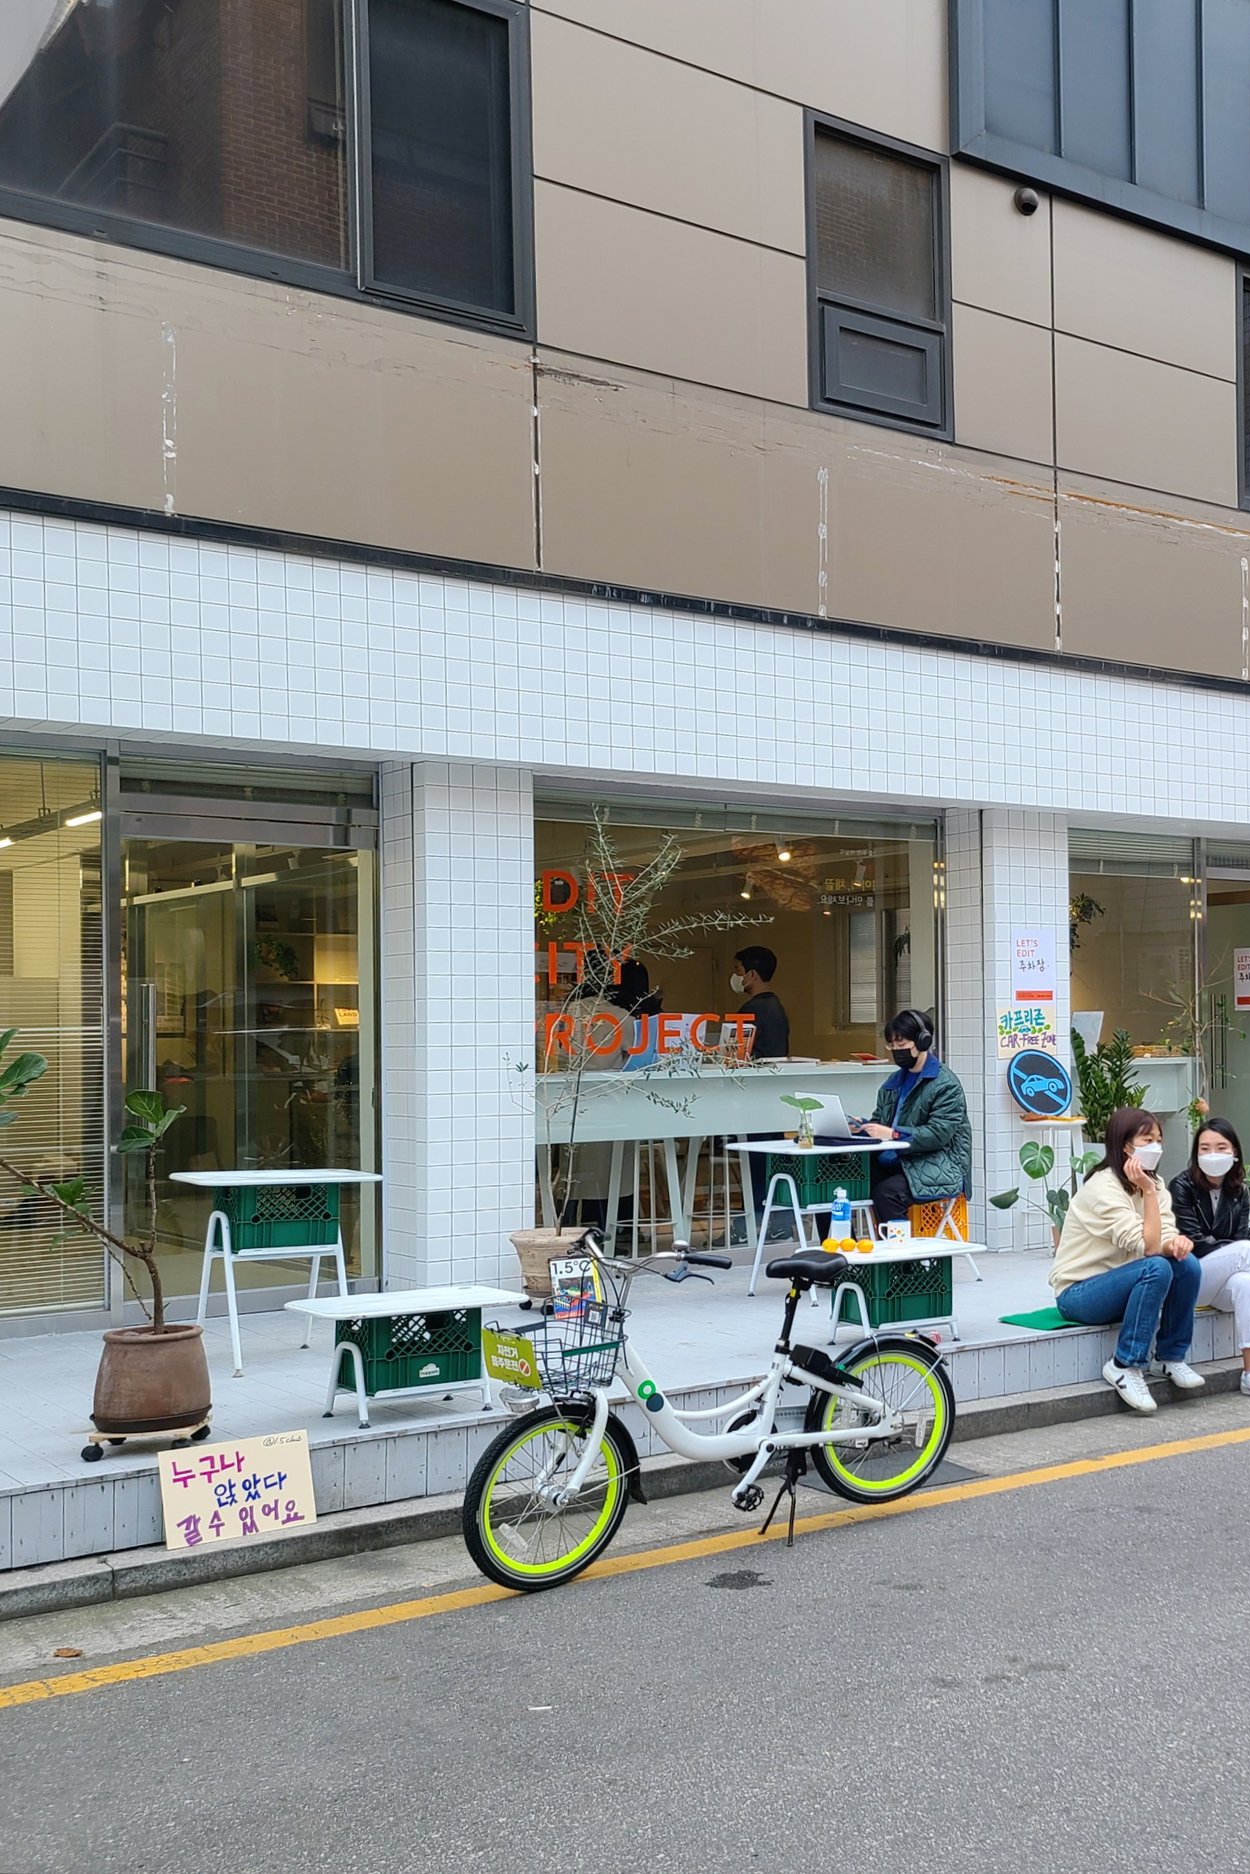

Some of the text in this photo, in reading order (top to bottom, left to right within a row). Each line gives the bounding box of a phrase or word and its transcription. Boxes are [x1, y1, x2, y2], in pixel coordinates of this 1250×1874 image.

[1016, 939, 1039, 947] LET'S
[535, 1013, 755, 1056] ROJECT
[1000, 1008, 1046, 1030] 카프리존
[171, 1450, 245, 1489] 누구나
[214, 1471, 288, 1508] 앉았다
